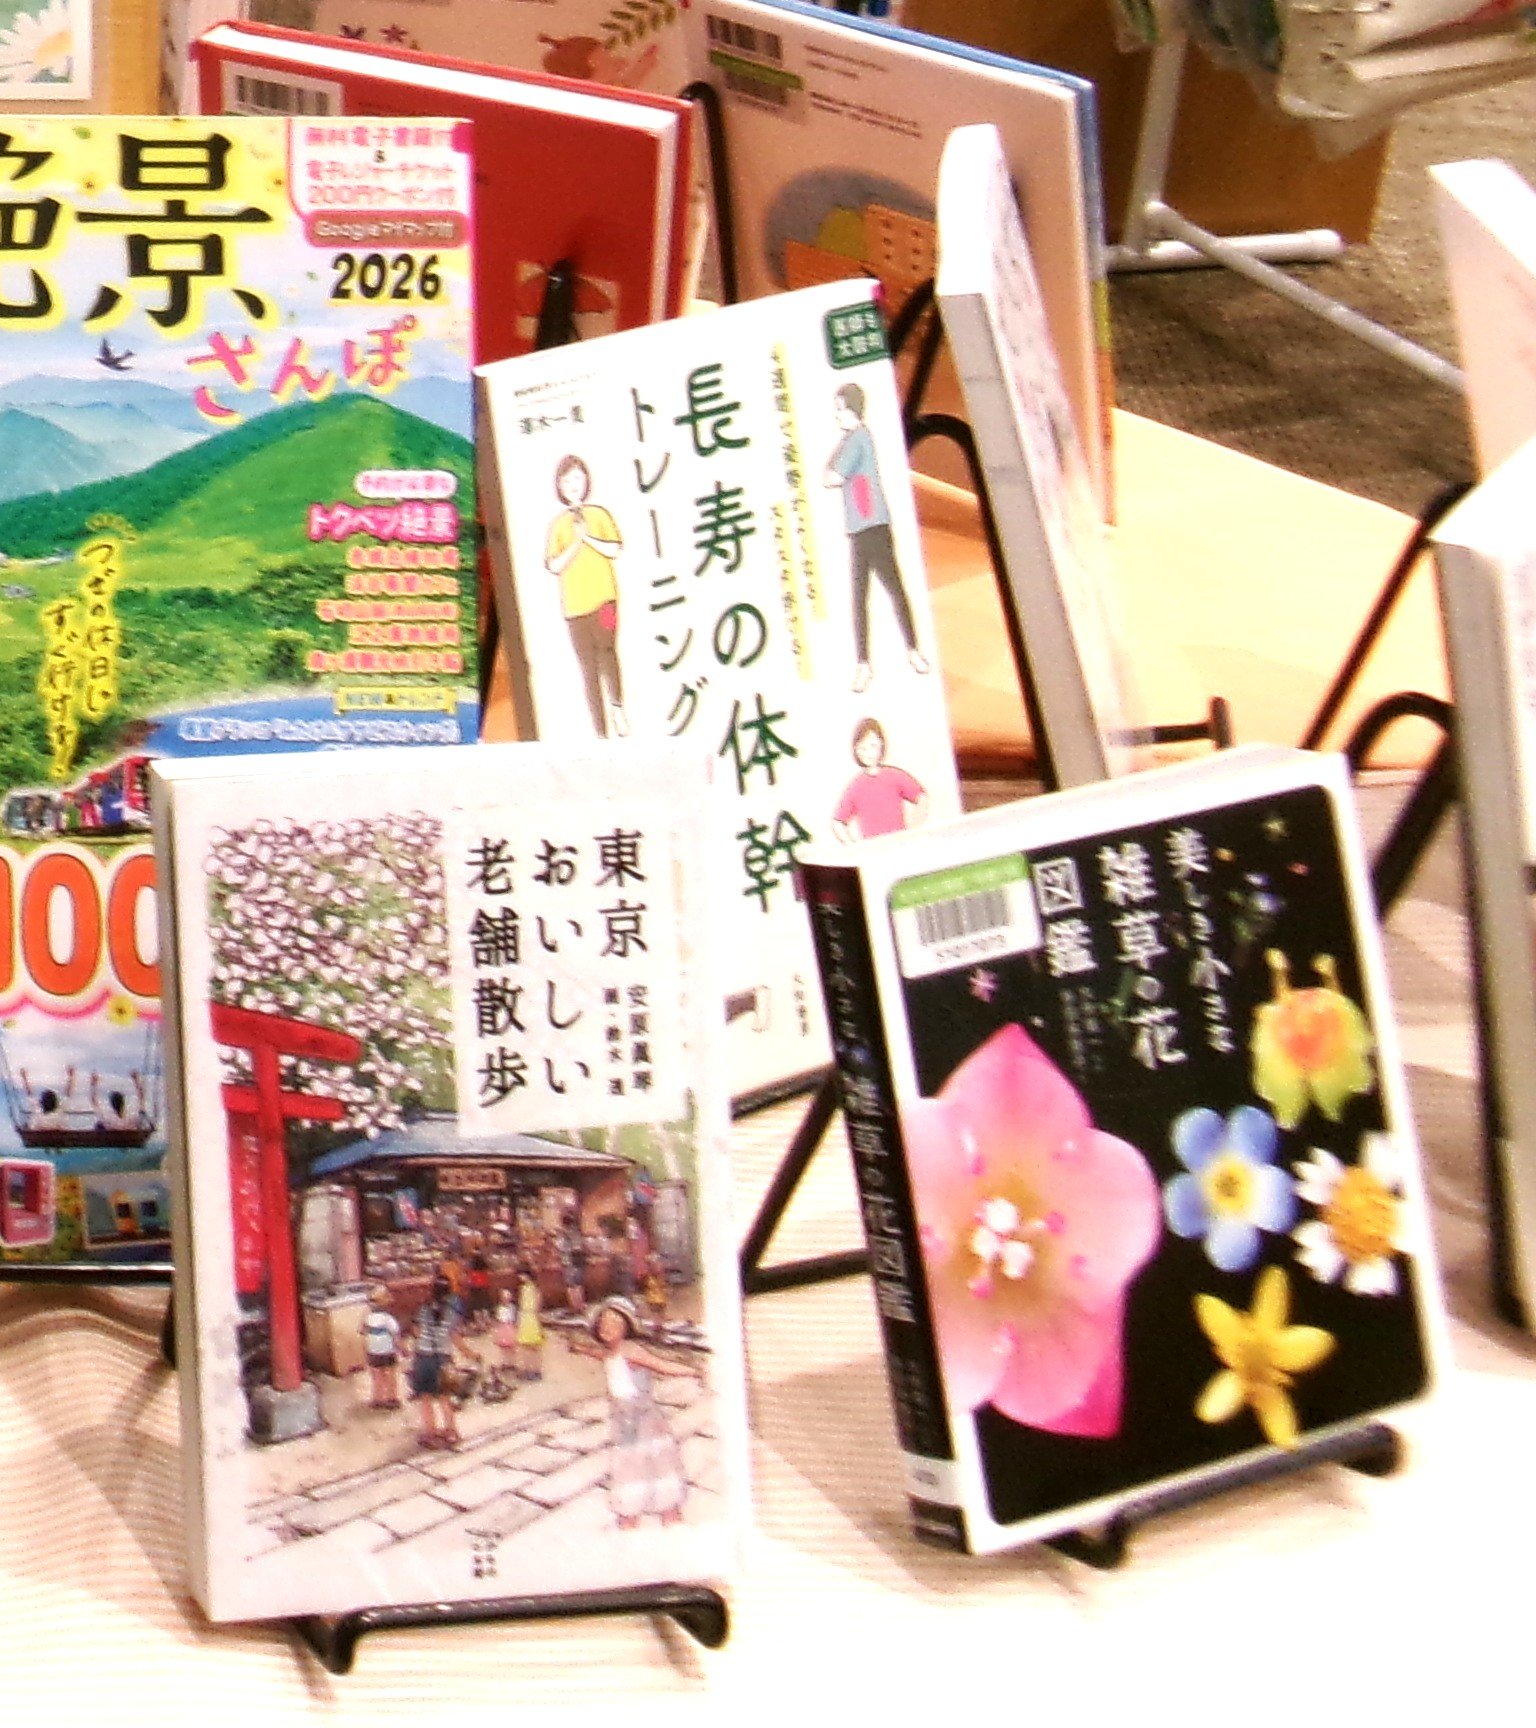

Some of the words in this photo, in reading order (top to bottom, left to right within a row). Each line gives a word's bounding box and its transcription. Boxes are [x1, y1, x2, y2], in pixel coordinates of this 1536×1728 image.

[185, 314, 418, 423] さんぽ
[330, 252, 443, 301] 2026
[630, 385, 709, 739] トレーニング
[673, 362, 813, 914] 長寿の体幹
[463, 836, 531, 1110] 老舗散歩
[531, 839, 591, 1100] おいしい
[592, 826, 651, 962] 東京
[1031, 855, 1099, 979] 図鑑
[1095, 839, 1189, 1071] 雑草の花
